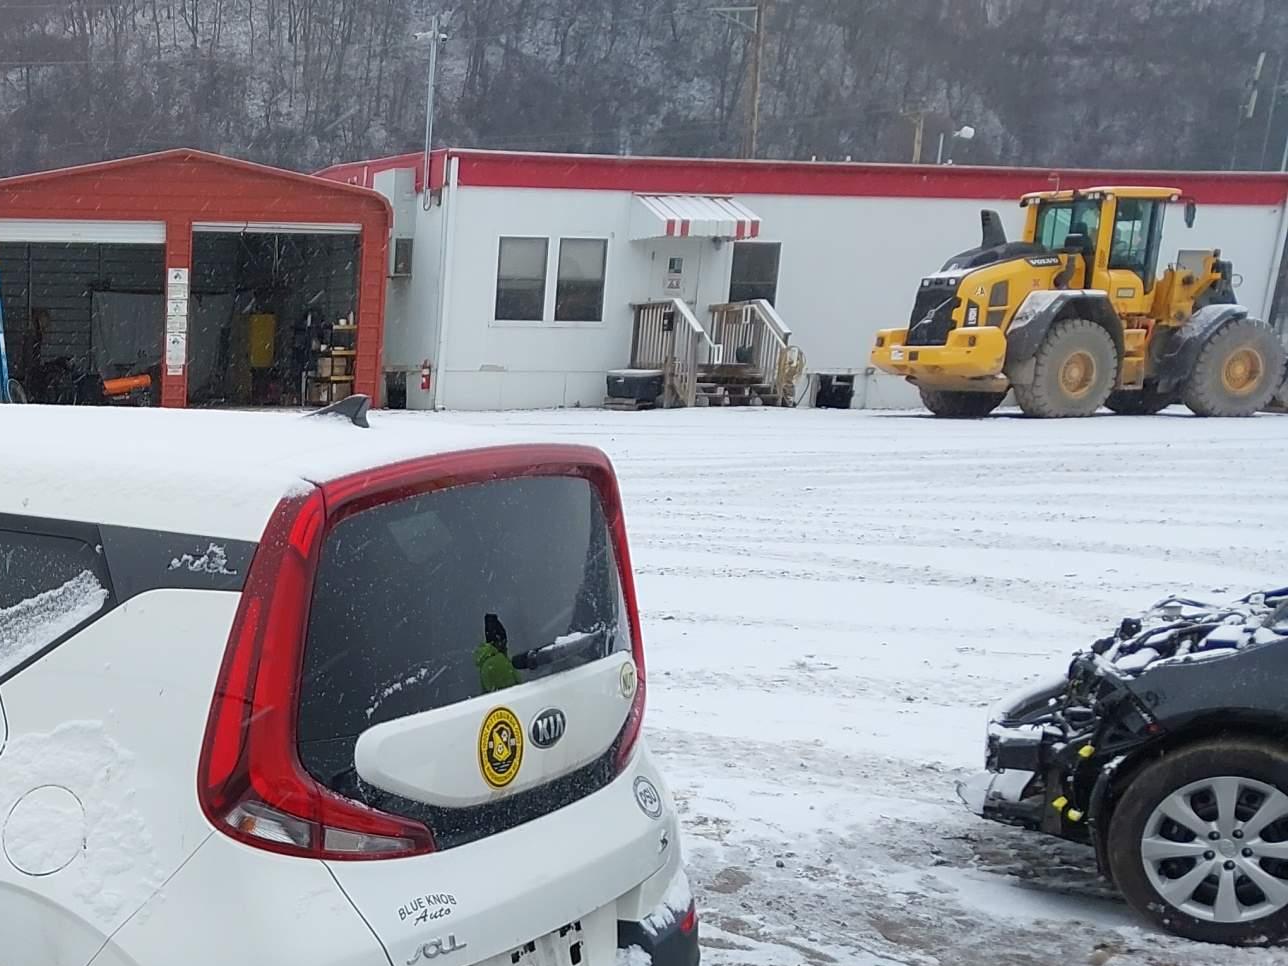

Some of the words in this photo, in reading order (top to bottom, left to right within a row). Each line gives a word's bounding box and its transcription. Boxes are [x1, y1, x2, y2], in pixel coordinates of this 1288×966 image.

[1029, 257, 1059, 265] VOLVO
[536, 713, 564, 743] KIA
[398, 897, 425, 921] BLUE
[424, 893, 457, 906] KNOB
[414, 907, 451, 926] Auto
[406, 934, 468, 966] SOUL
